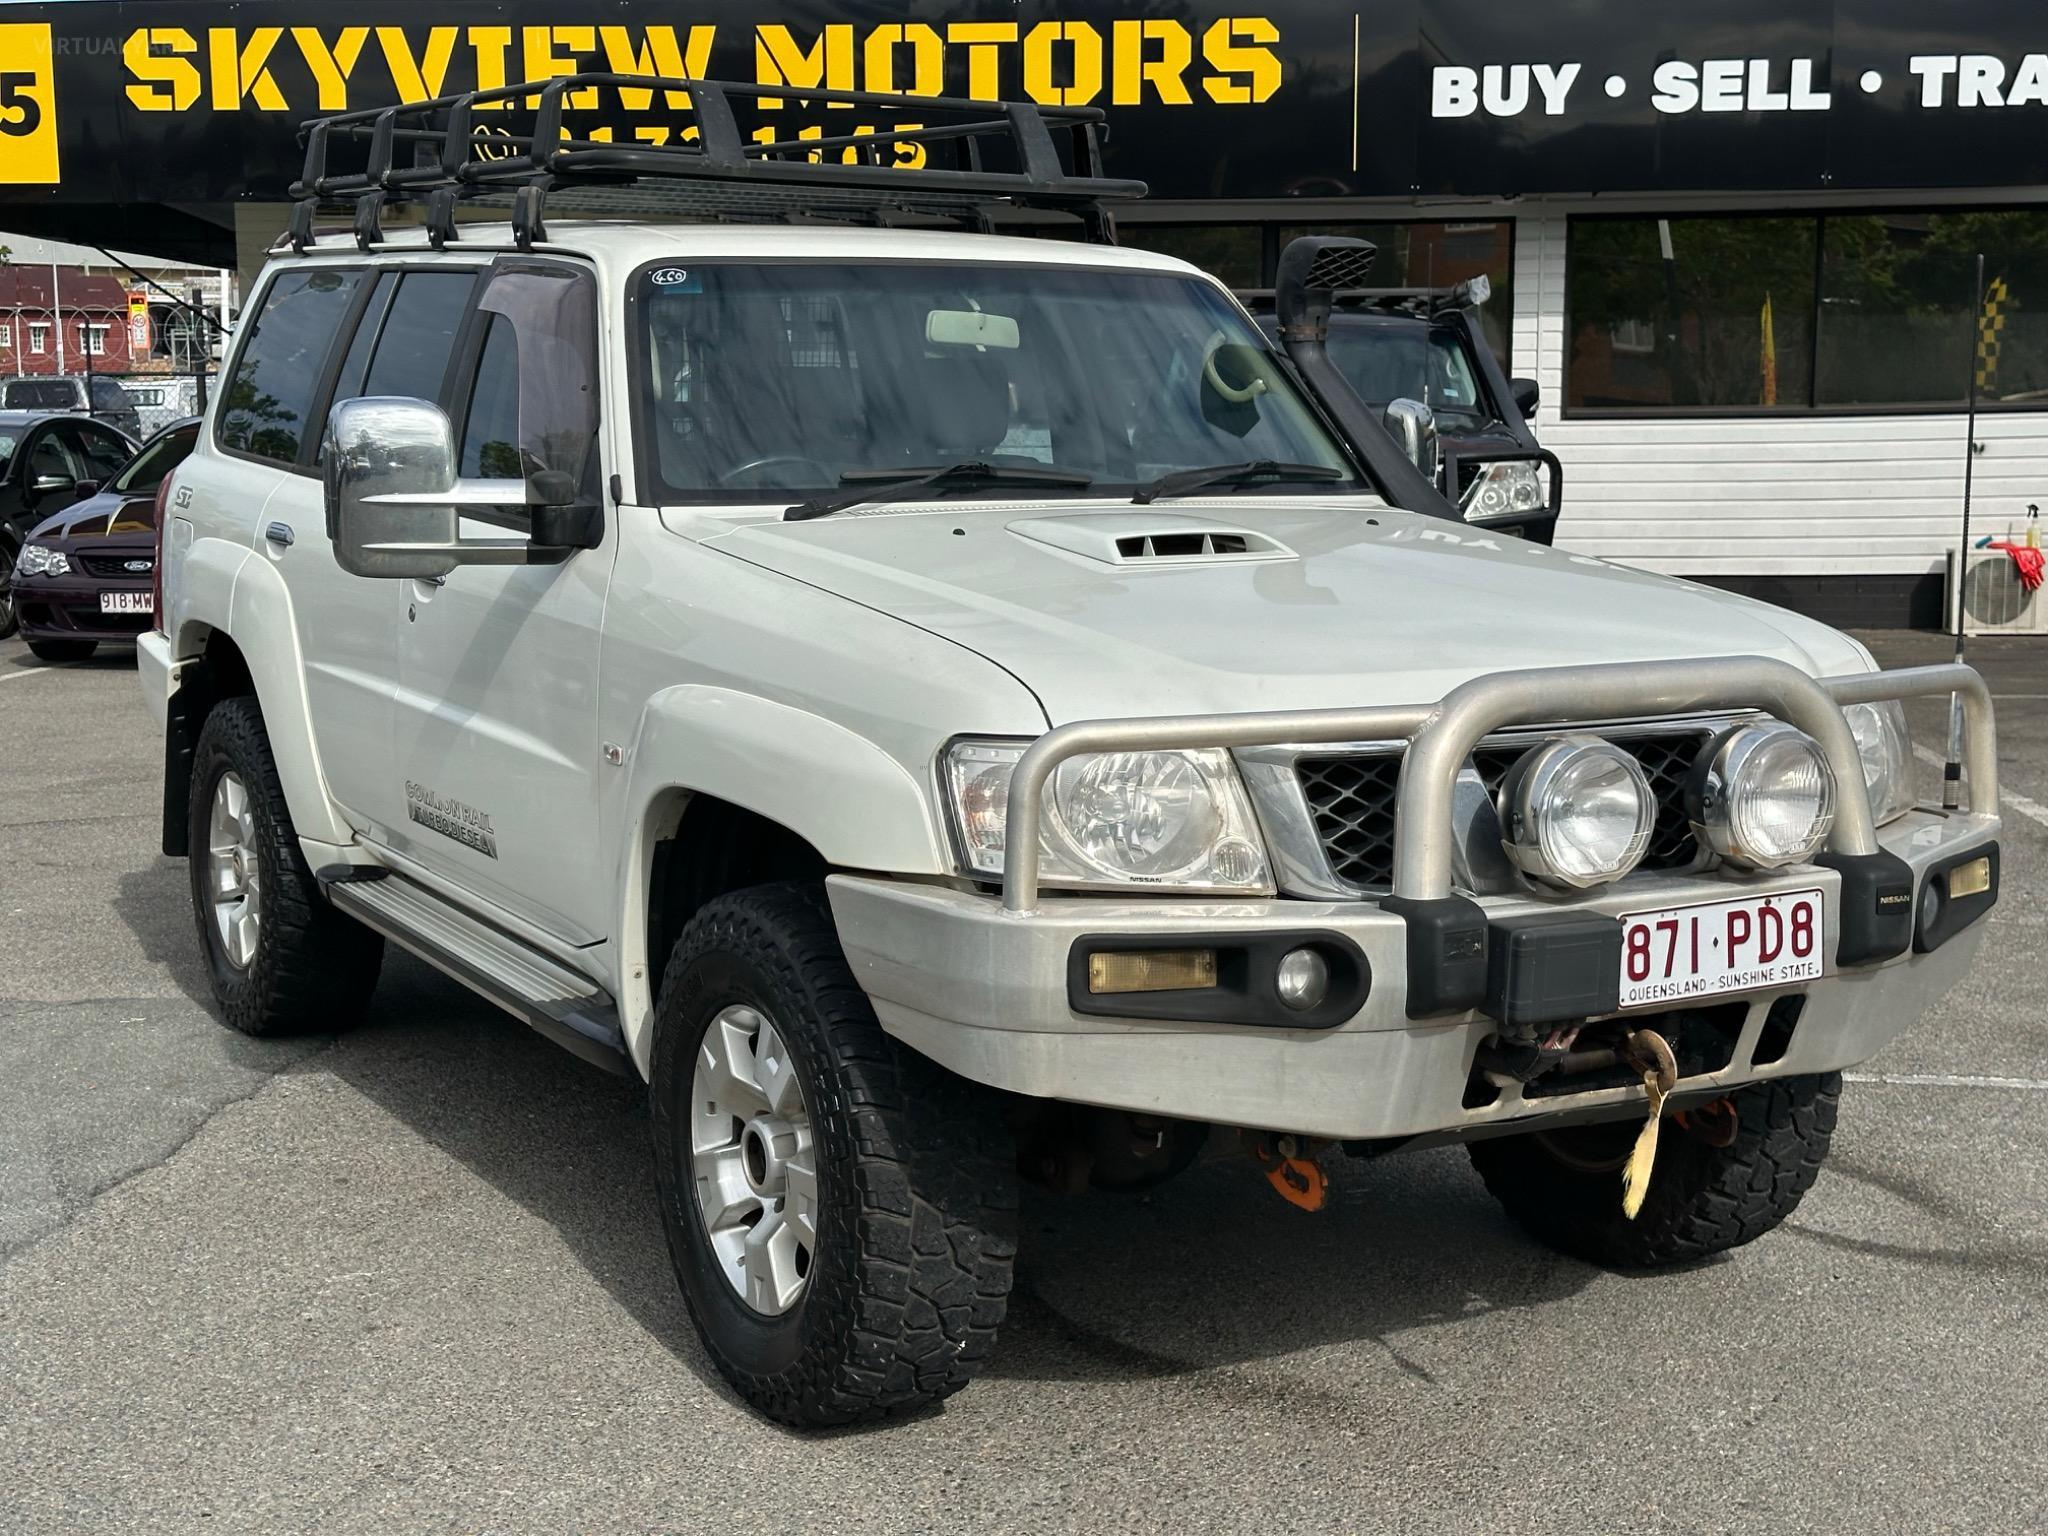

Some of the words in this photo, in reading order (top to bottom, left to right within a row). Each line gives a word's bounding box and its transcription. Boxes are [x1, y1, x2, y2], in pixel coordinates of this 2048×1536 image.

[123, 26, 715, 111] SKYVIEW
[756, 18, 1281, 109] MOTORS
[1431, 63, 1581, 117] BUY
[1651, 58, 1831, 113] SELL
[0, 72, 41, 136] 5
[1880, 895, 1910, 904] NISSAN
[1629, 978, 1707, 1001] QUEENSLAND
[1718, 967, 1774, 989] SUNSHINE
[1780, 961, 1814, 979] STATE
